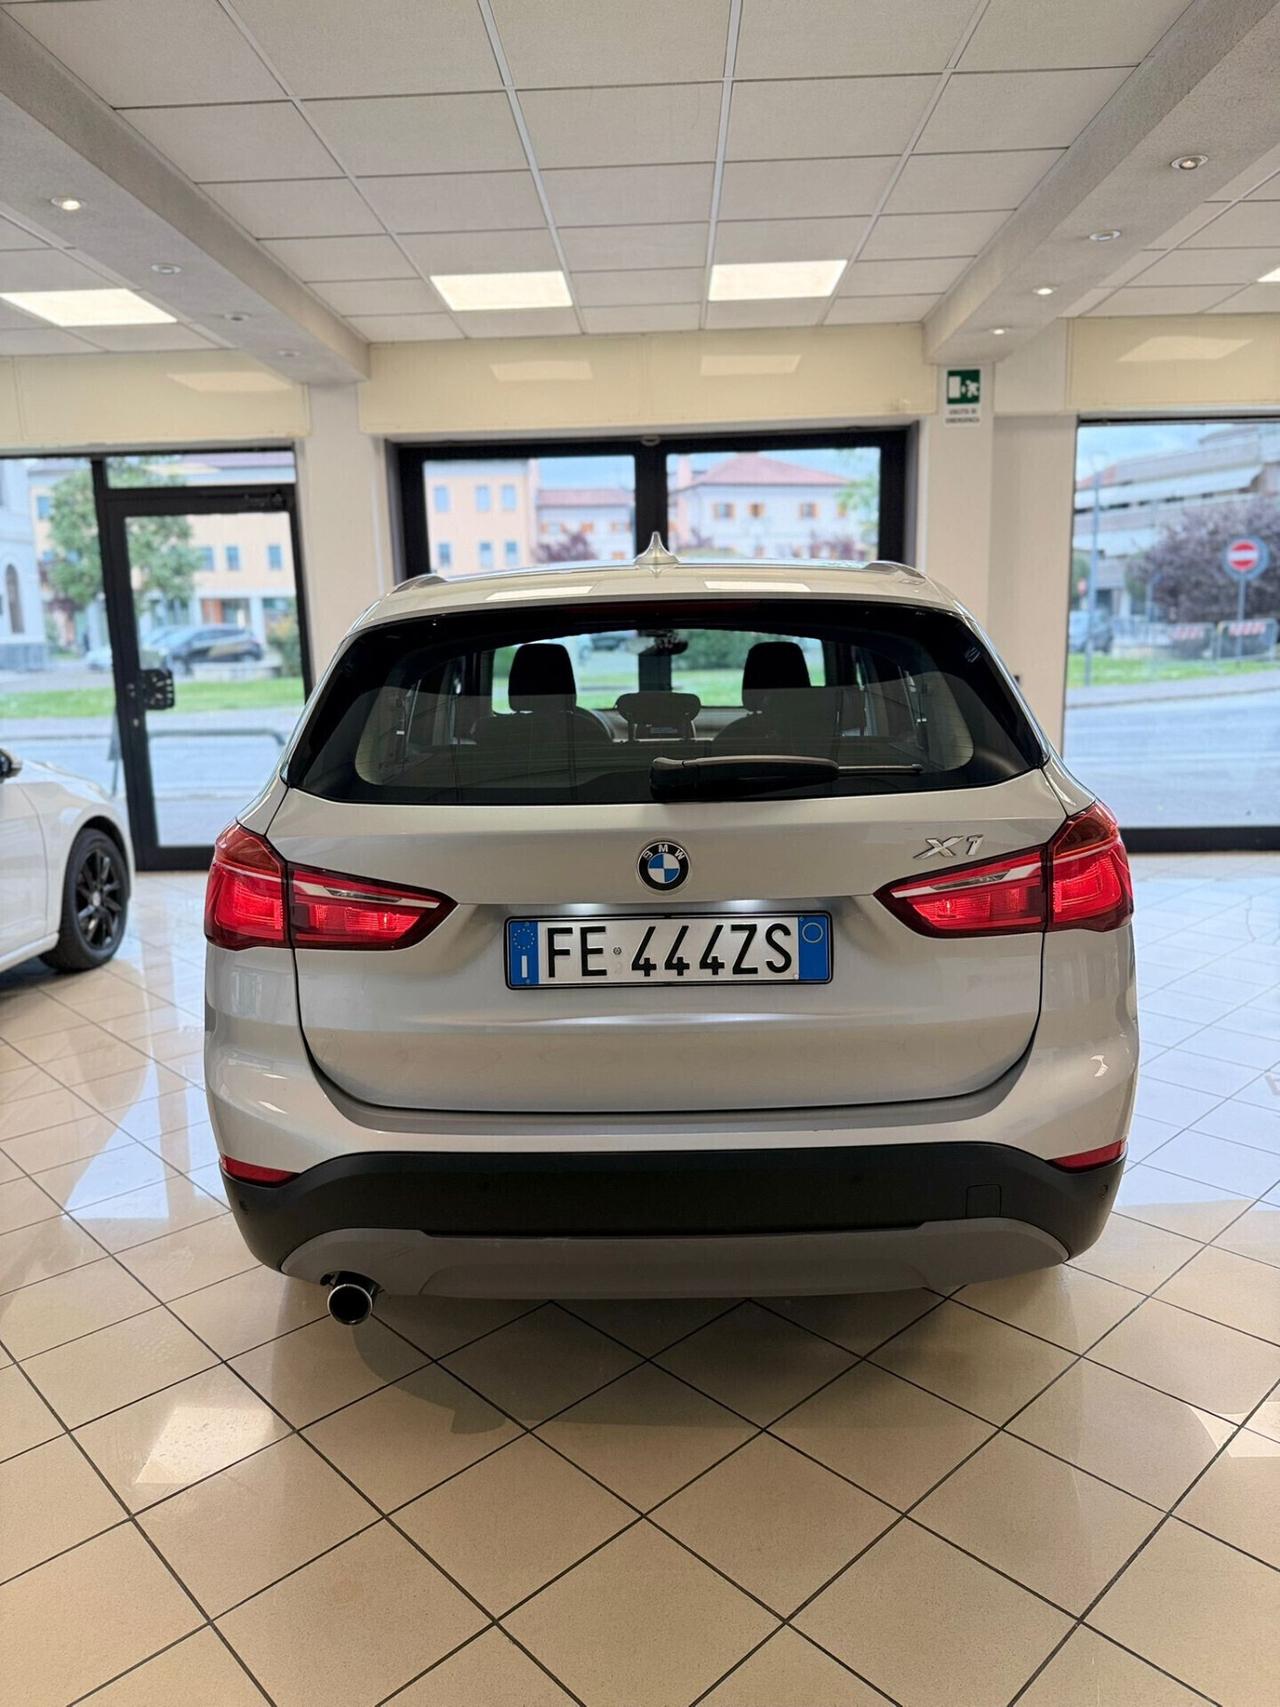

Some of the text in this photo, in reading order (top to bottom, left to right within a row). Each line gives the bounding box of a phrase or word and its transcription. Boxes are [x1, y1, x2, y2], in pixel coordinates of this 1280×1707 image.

[642, 844, 686, 861] BMW
[912, 834, 984, 859] X1
[547, 923, 793, 978] FE 444ZS
